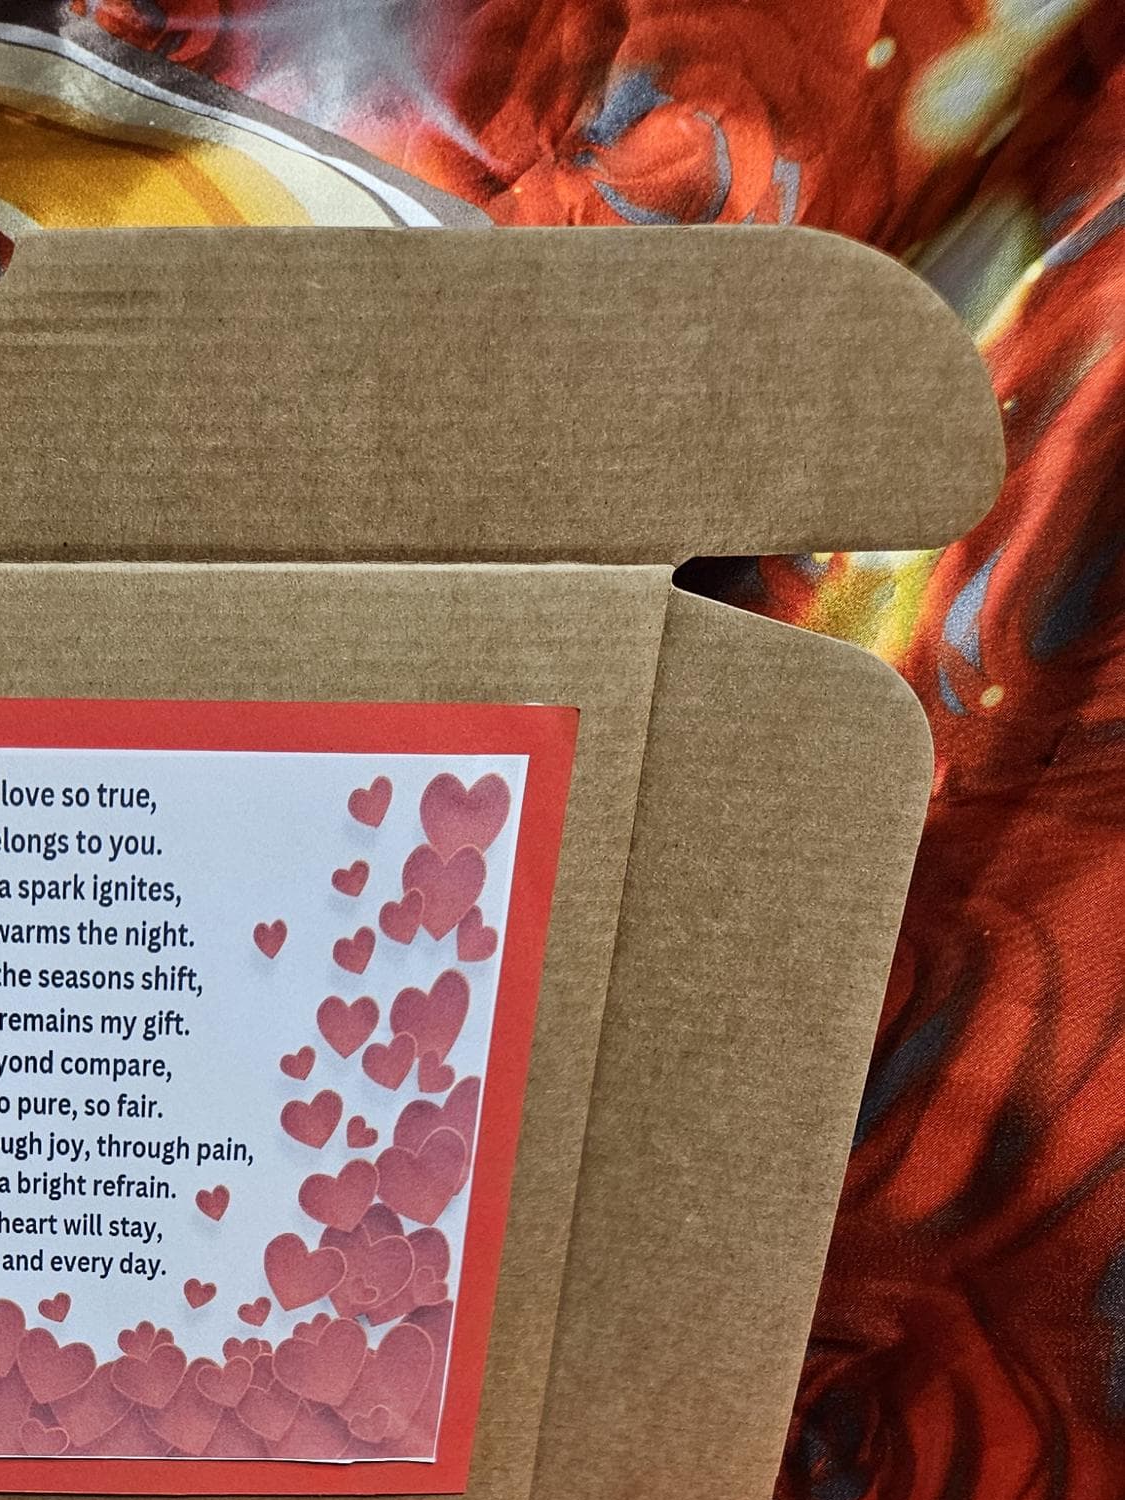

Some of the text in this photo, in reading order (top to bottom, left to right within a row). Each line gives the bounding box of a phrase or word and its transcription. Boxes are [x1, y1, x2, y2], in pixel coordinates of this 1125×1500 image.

[1, 779, 55, 807] love
[61, 787, 90, 808] so
[96, 783, 157, 816] true,
[75, 830, 103, 855] to
[108, 834, 163, 863] you.
[18, 873, 86, 907] spark
[92, 873, 182, 908] ignites,
[76, 918, 118, 946] the
[125, 920, 195, 954] night.
[38, 969, 135, 990] seasons
[140, 964, 203, 998] shift,
[100, 1015, 138, 1041] my
[142, 1009, 190, 1042] gift.
[60, 1056, 172, 1083] compare,
[17, 1096, 78, 1121] pure,
[83, 1098, 111, 1117] so
[117, 1093, 163, 1119] fair.
[46, 1131, 91, 1163] joy,
[96, 1133, 190, 1166] through
[196, 1136, 254, 1167] pain,
[17, 1170, 87, 1201] bright
[93, 1173, 177, 1199] refrain.
[63, 1212, 103, 1237] will
[108, 1216, 163, 1245] stay,
[2, 1248, 44, 1272] and
[50, 1255, 114, 1280] every
[119, 1251, 167, 1281] day.
